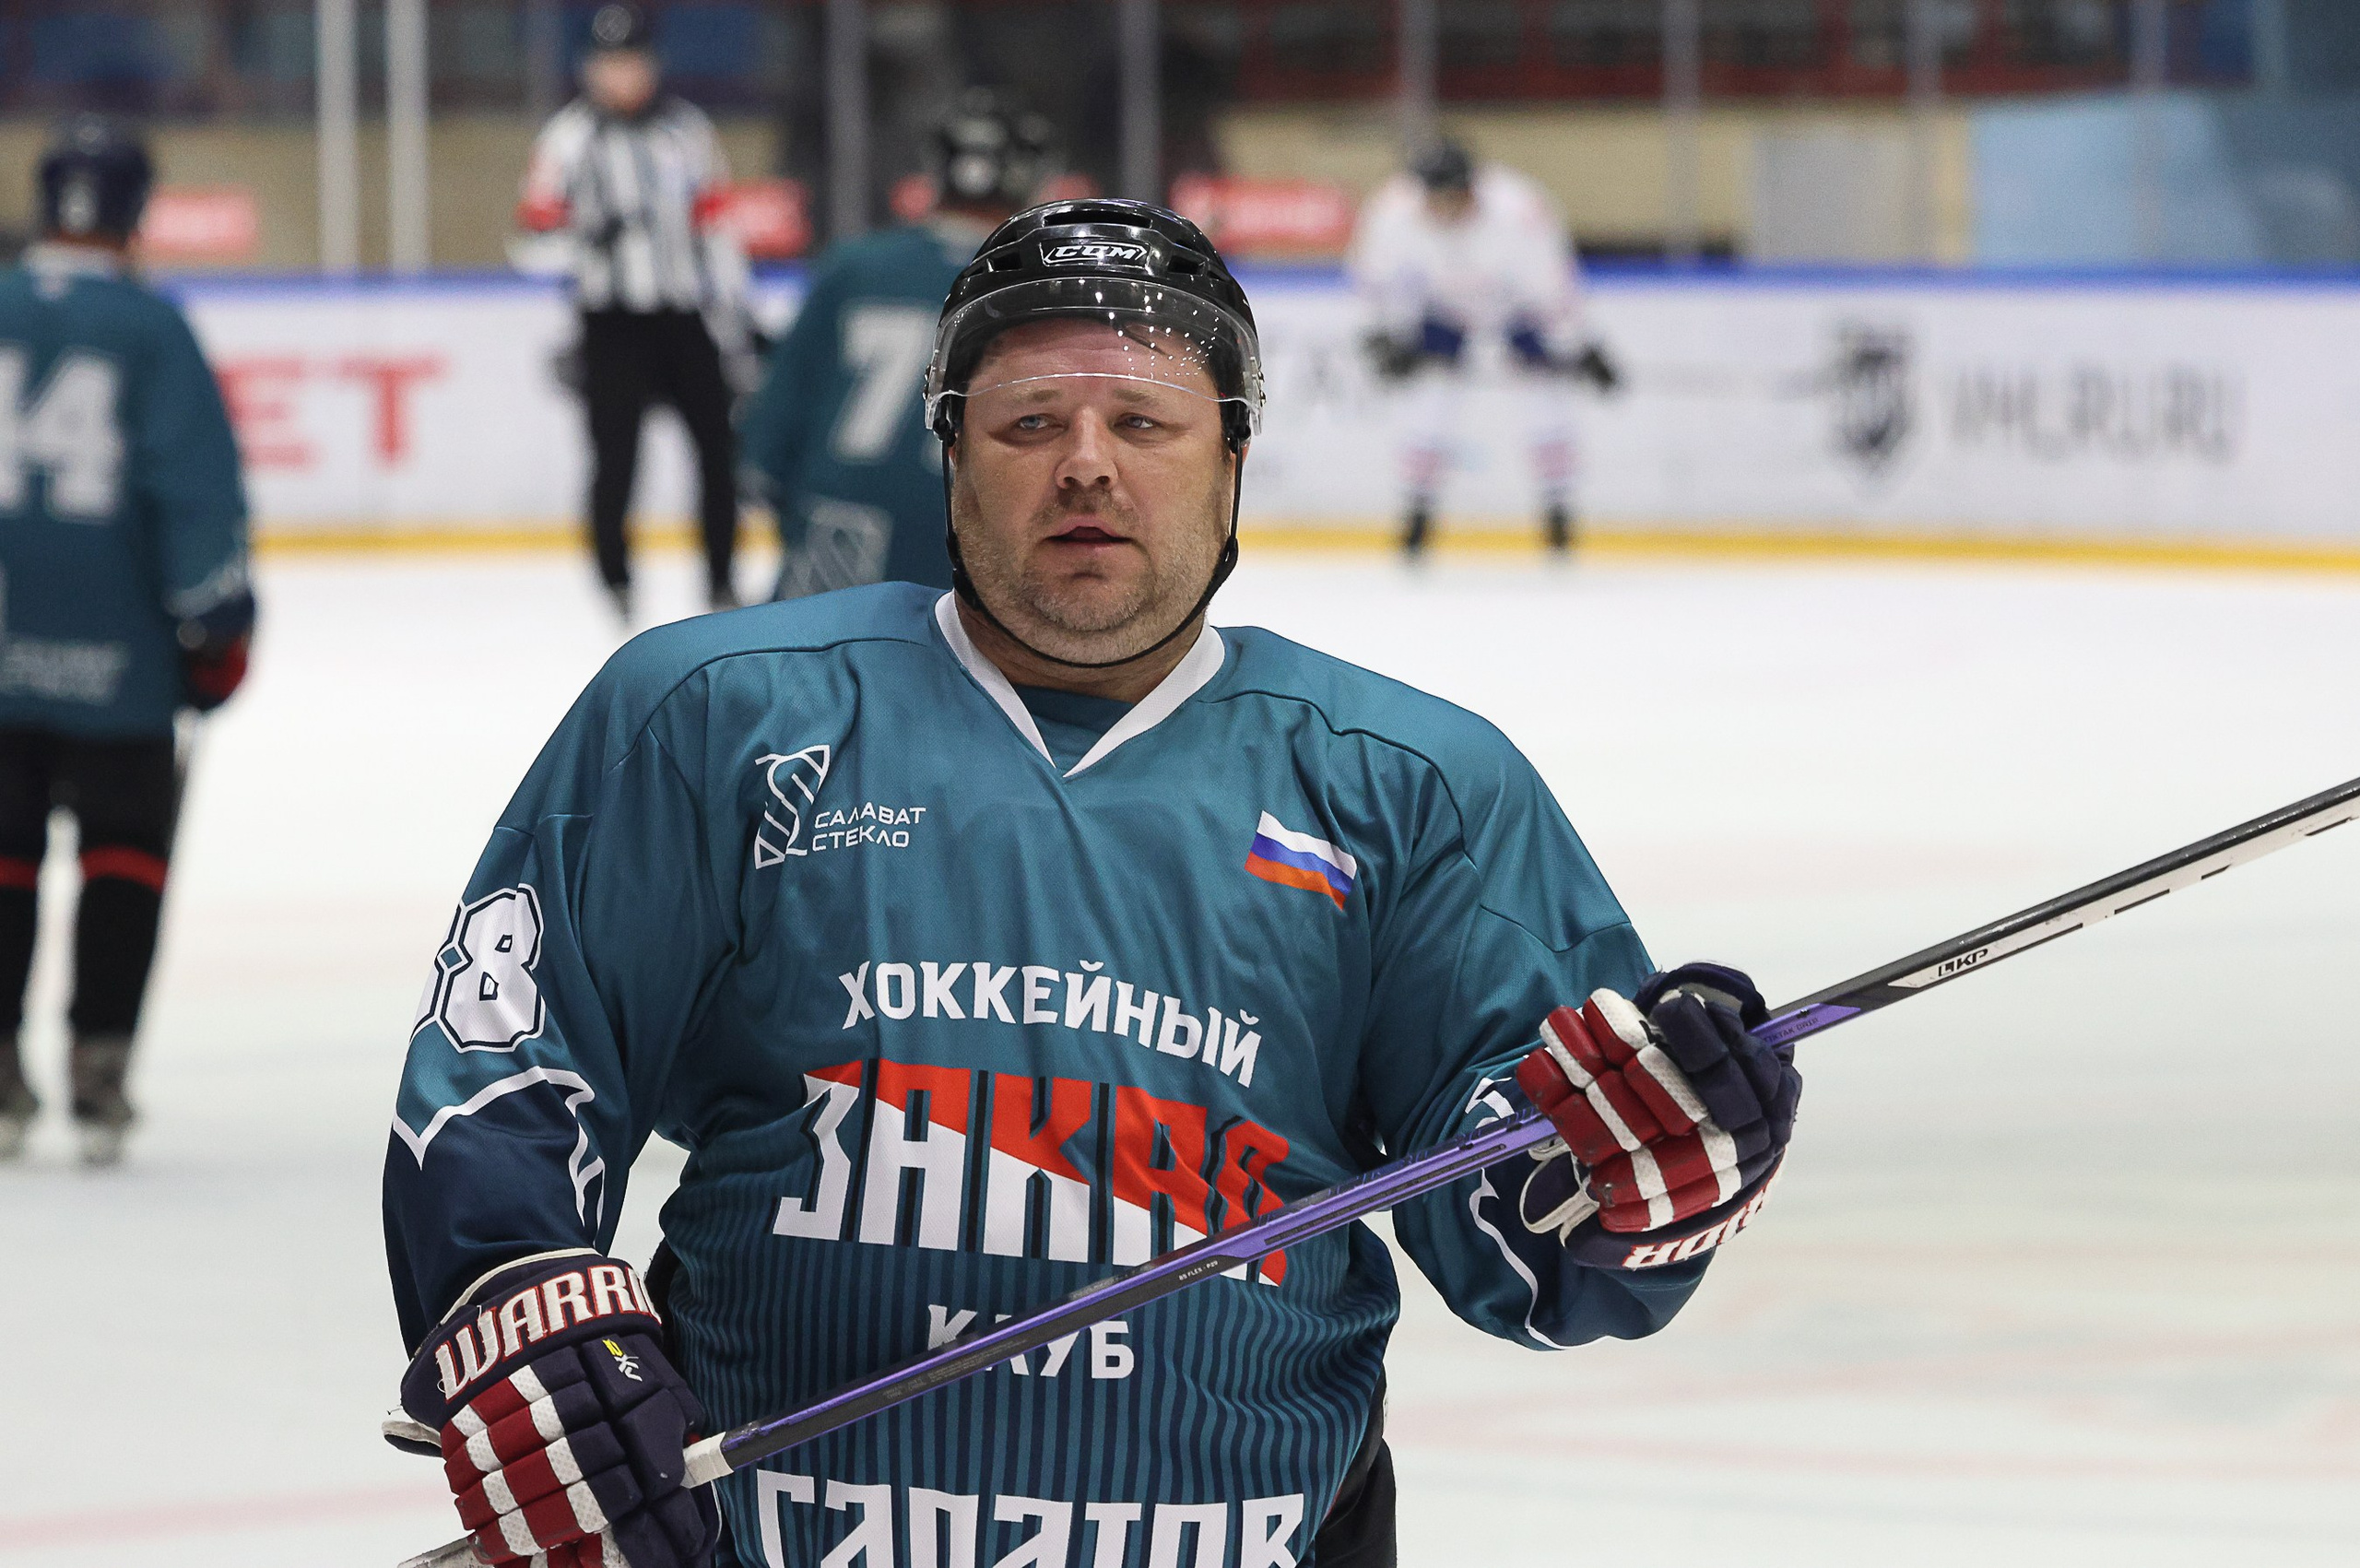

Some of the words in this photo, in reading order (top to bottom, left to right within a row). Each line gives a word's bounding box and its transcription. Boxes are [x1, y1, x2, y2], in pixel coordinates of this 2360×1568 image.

[1055, 244, 1140, 260] CCM
[815, 801, 926, 829] САЛАВАТ
[812, 825, 910, 851] СТЕКЛО
[838, 960, 1262, 1089] ХОККЕЙНЫЙ
[435, 1263, 663, 1402] WARRI
